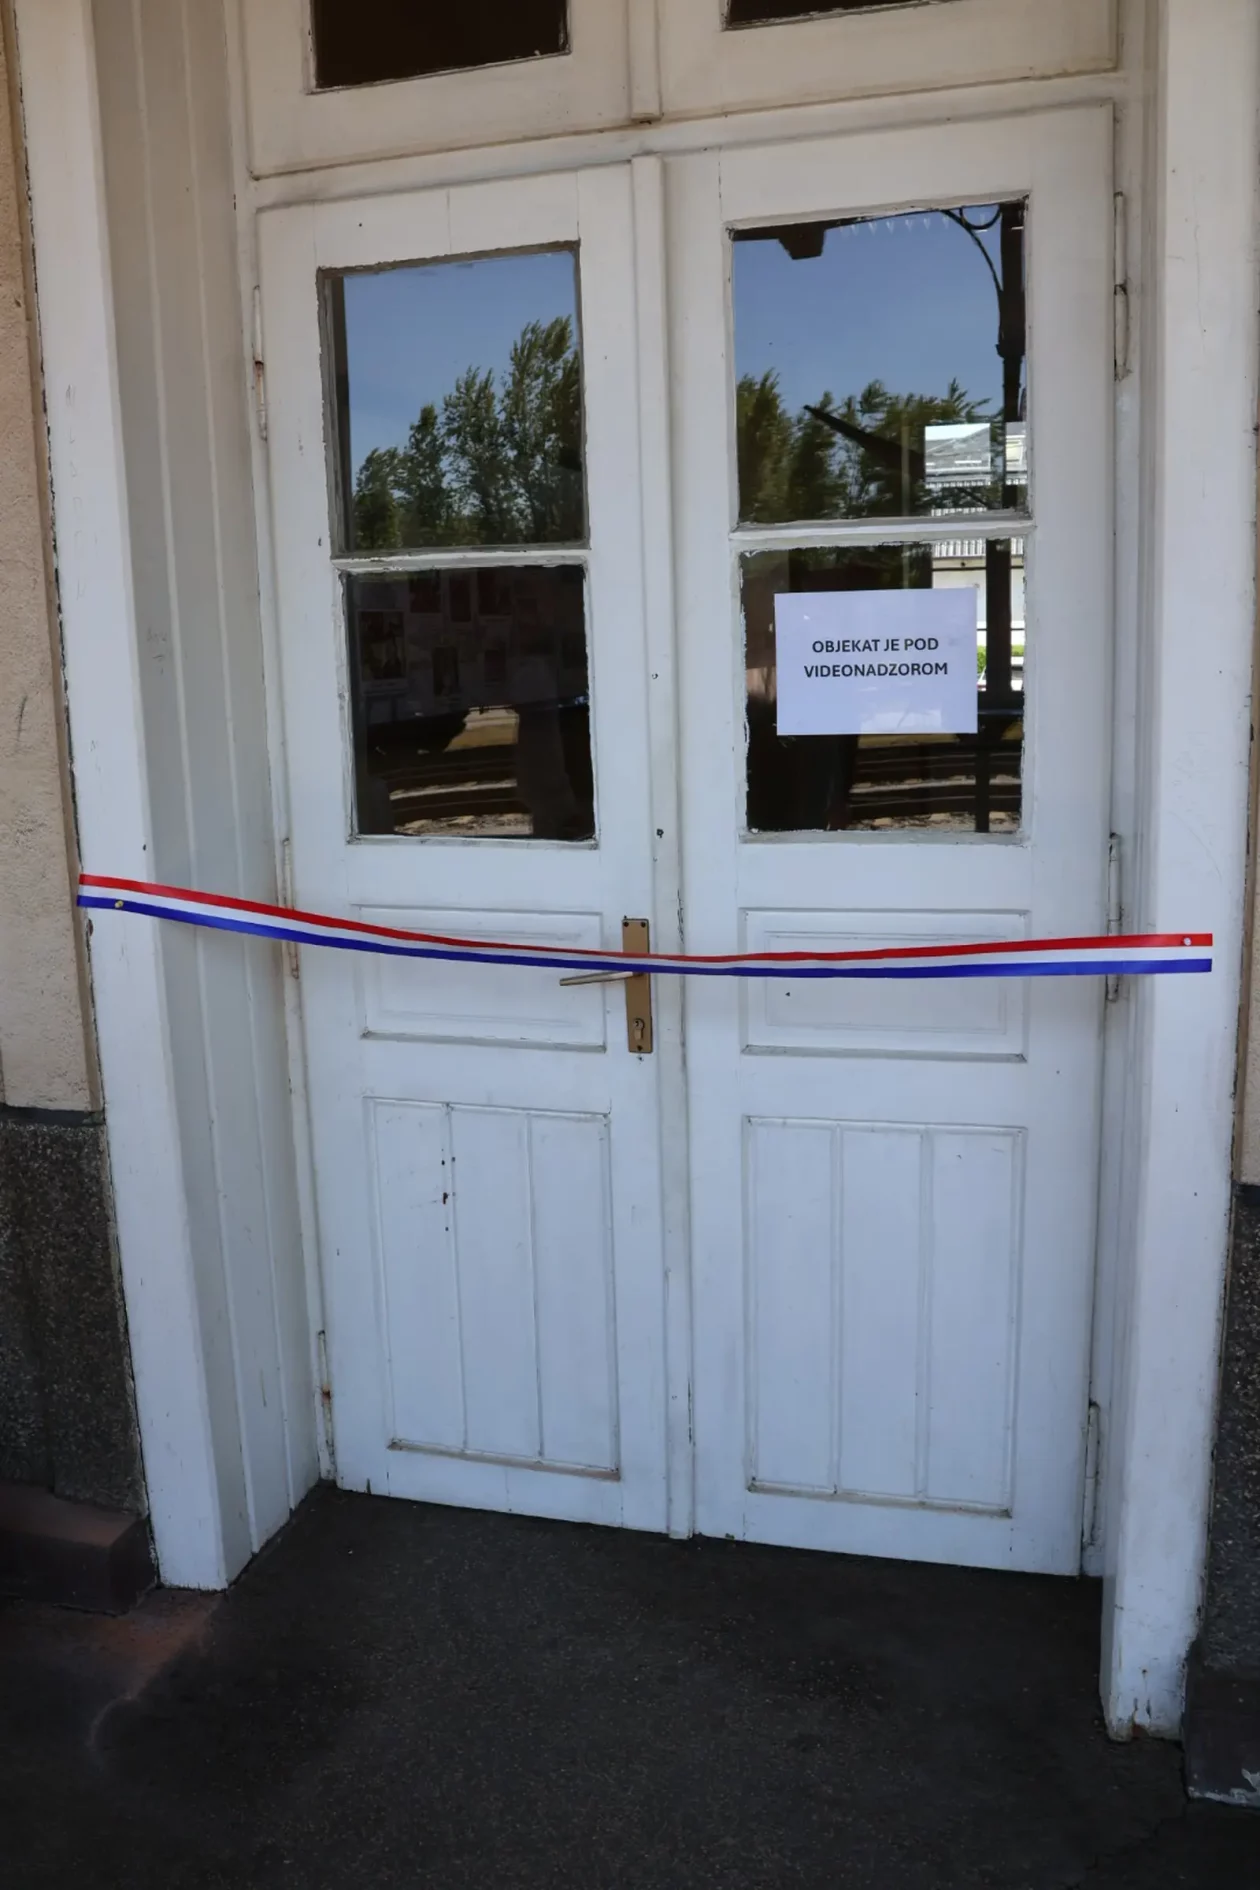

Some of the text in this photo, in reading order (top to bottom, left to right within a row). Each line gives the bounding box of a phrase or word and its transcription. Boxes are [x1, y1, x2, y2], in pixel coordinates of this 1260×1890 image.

[811, 637, 940, 654] OBJEKAT JE POD
[803, 661, 949, 678] VIDEONADZOROM
